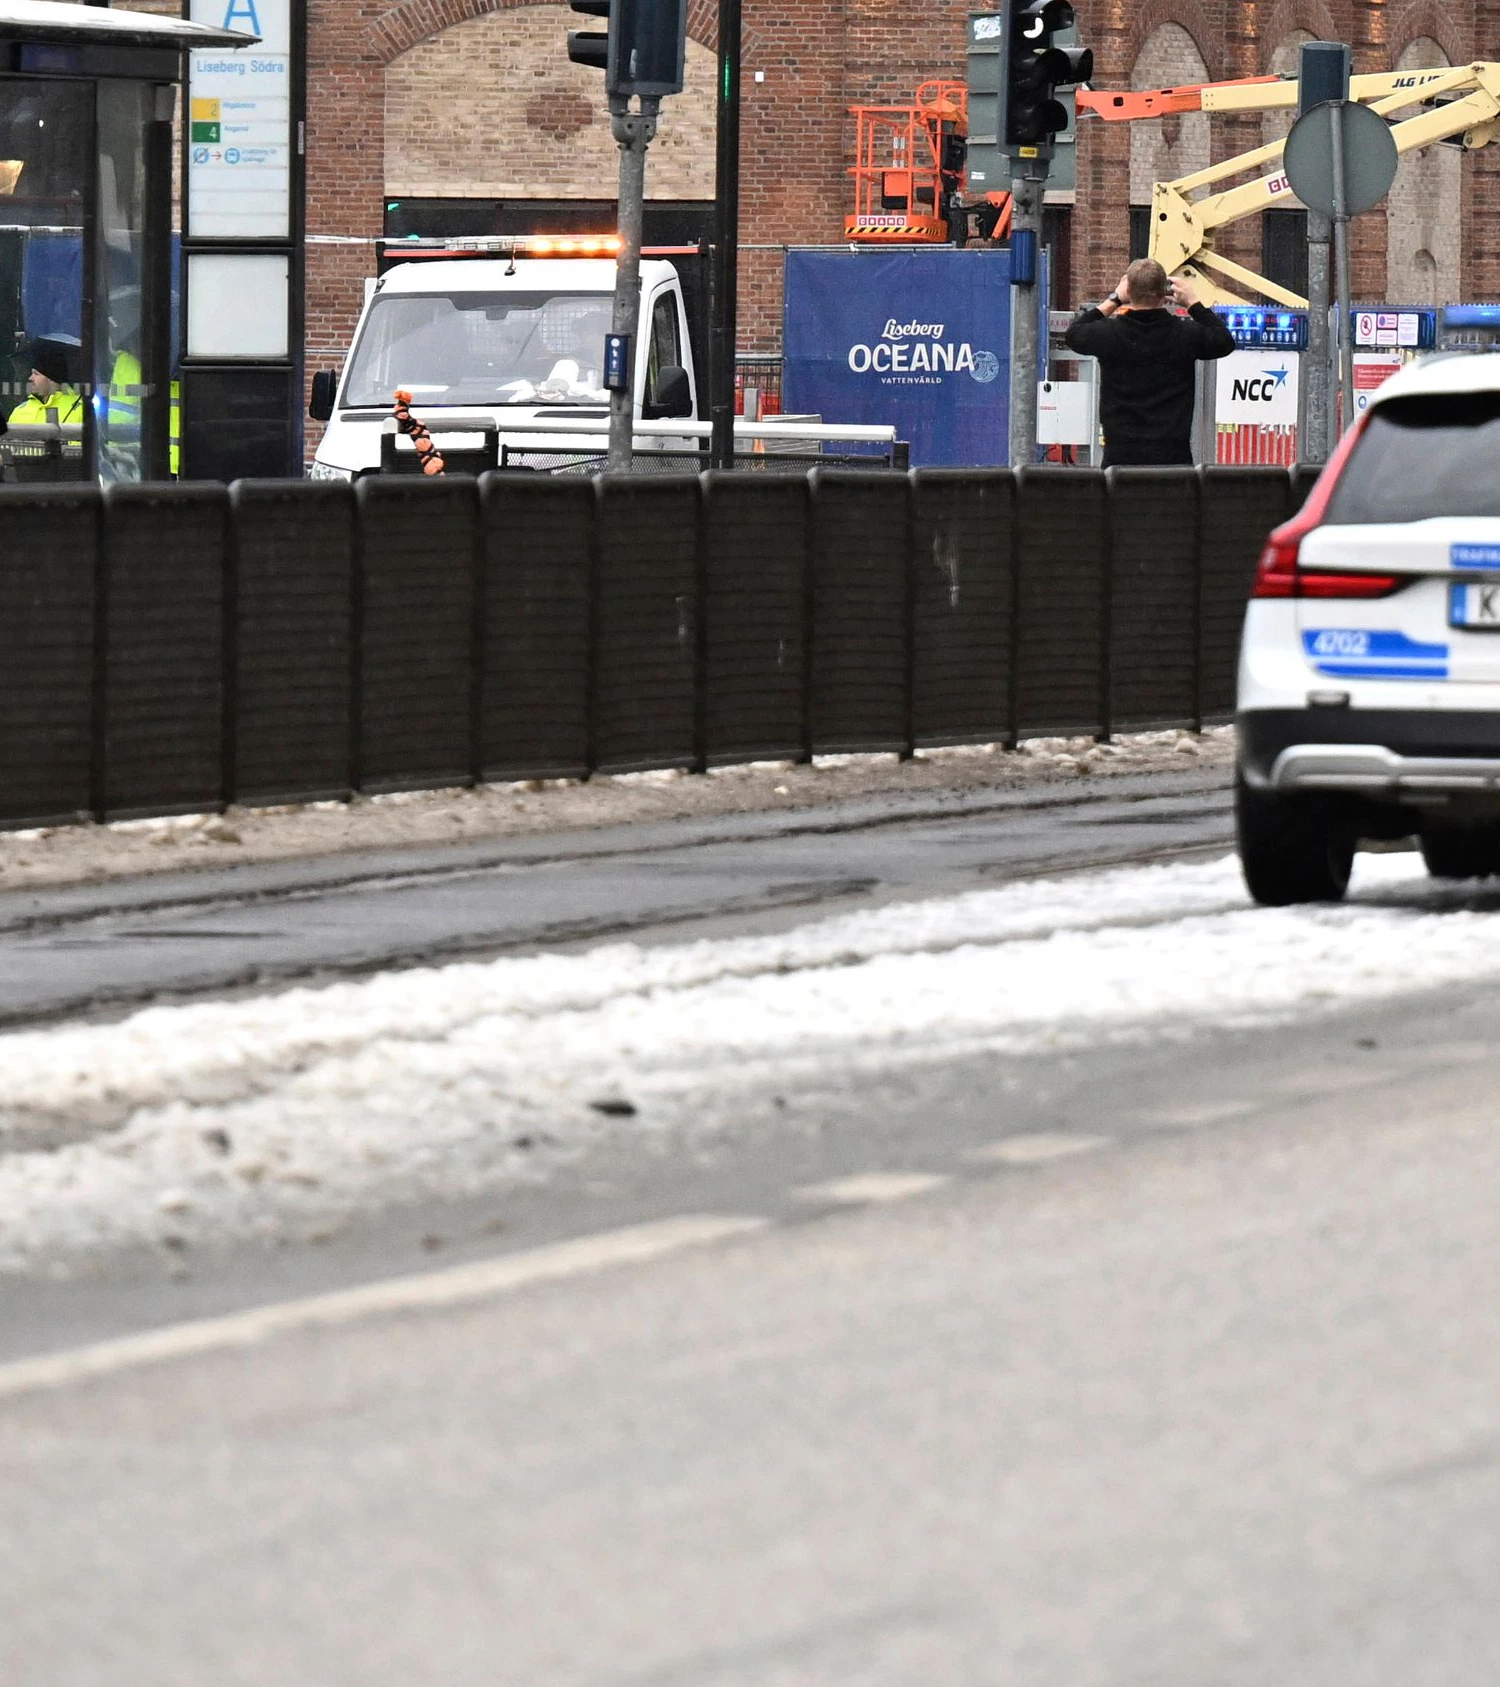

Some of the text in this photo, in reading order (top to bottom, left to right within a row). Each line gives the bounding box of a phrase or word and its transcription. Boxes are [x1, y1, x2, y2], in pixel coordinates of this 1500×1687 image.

[197, 60, 284, 75] Liseberg Södra
[1392, 74, 1444, 89] JLG LI
[210, 102, 217, 116] 2
[209, 126, 218, 139] 4
[881, 318, 945, 341] Liseberg
[848, 343, 976, 373] OCEANA
[880, 375, 942, 384] VATTENVÄRLD
[1231, 378, 1274, 402] NCC
